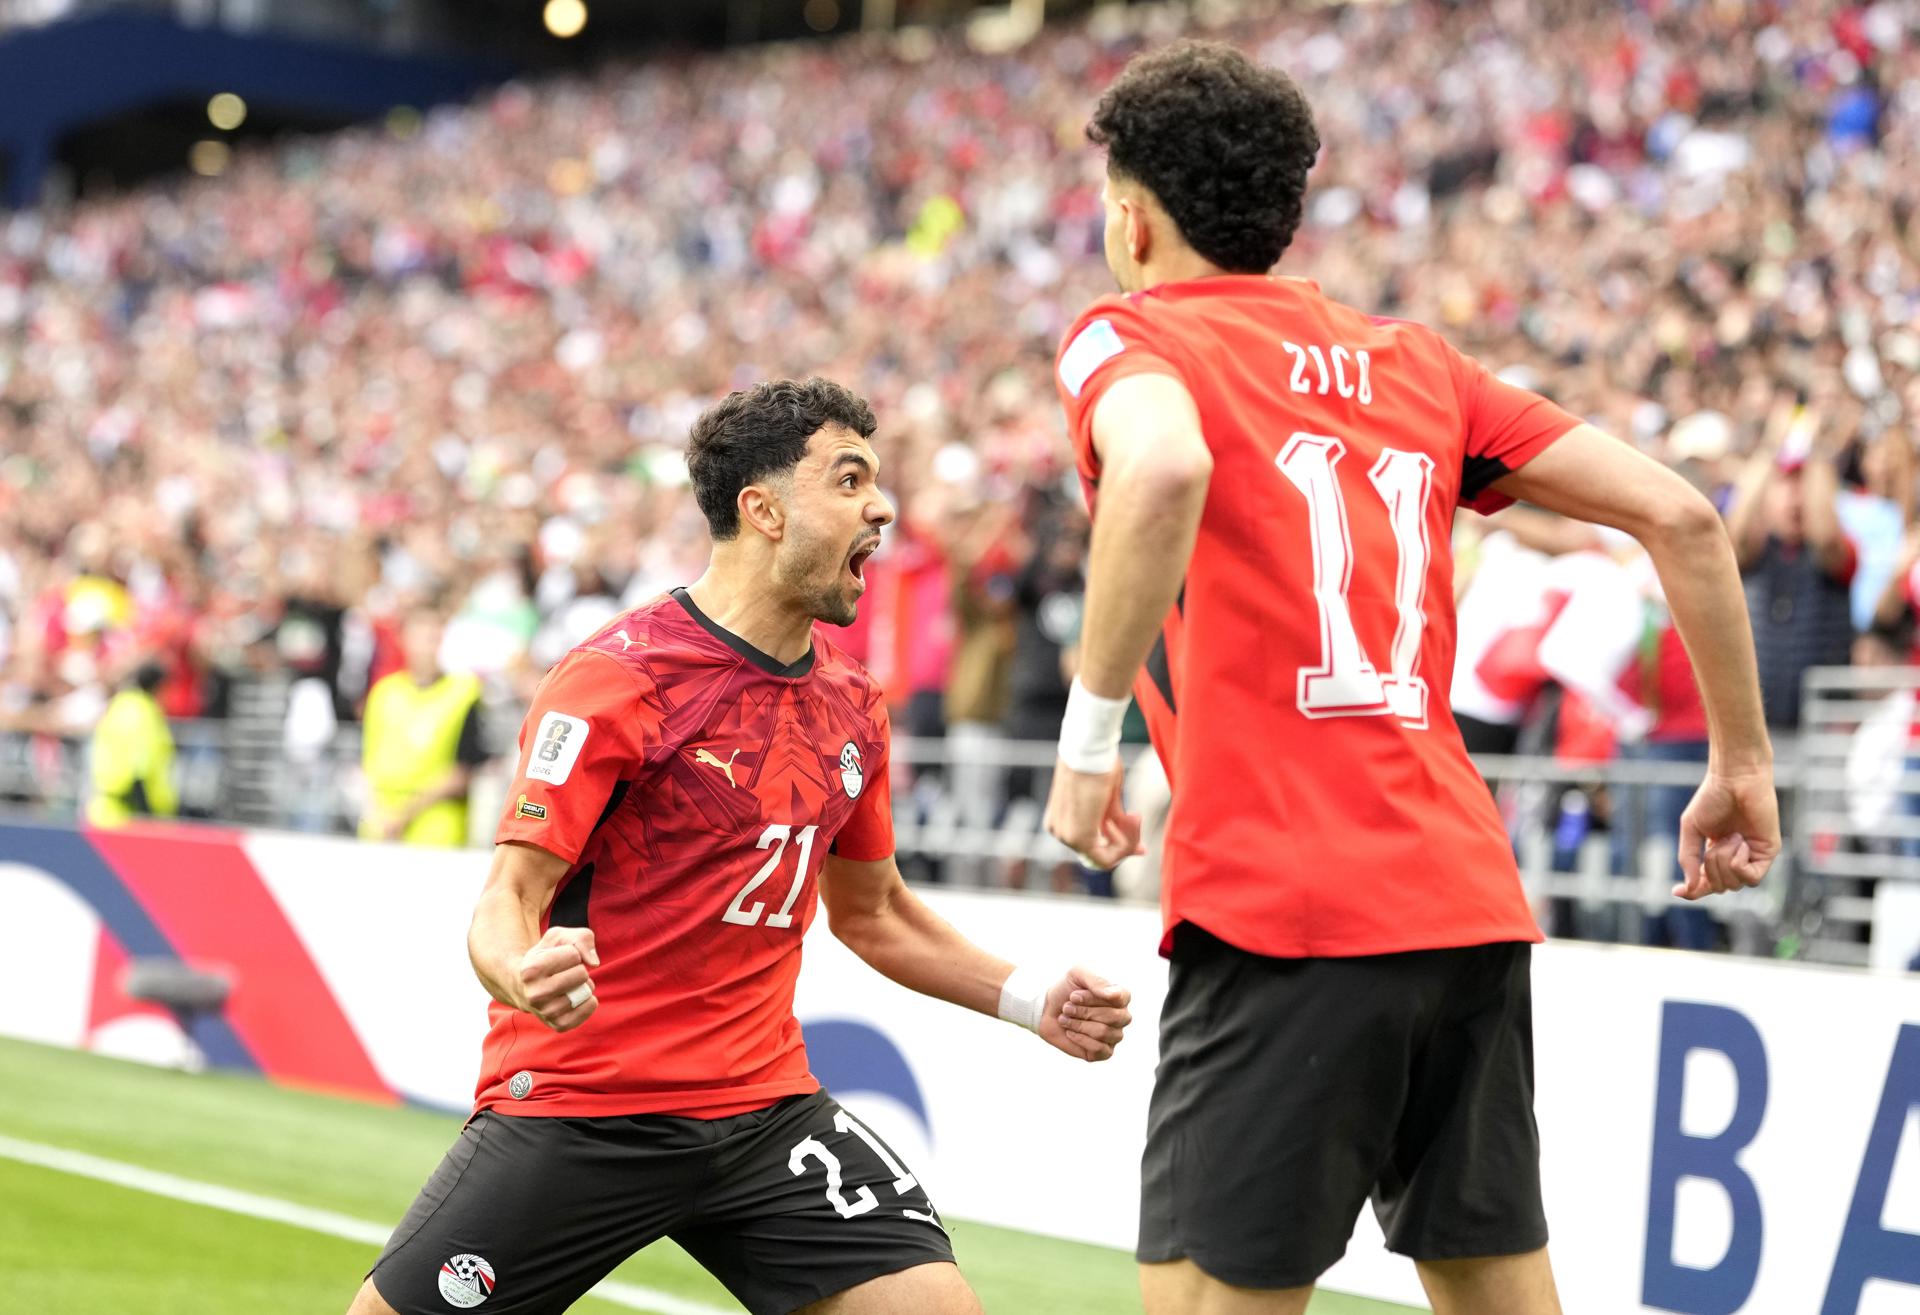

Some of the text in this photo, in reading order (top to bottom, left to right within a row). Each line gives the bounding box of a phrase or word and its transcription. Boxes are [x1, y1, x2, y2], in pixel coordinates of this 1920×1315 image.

[1282, 341, 1372, 405] ZICO
[1275, 431, 1435, 730] 11
[523, 804, 544, 813] DEBUT
[721, 824, 819, 928] 21
[788, 1109, 918, 1219] 21
